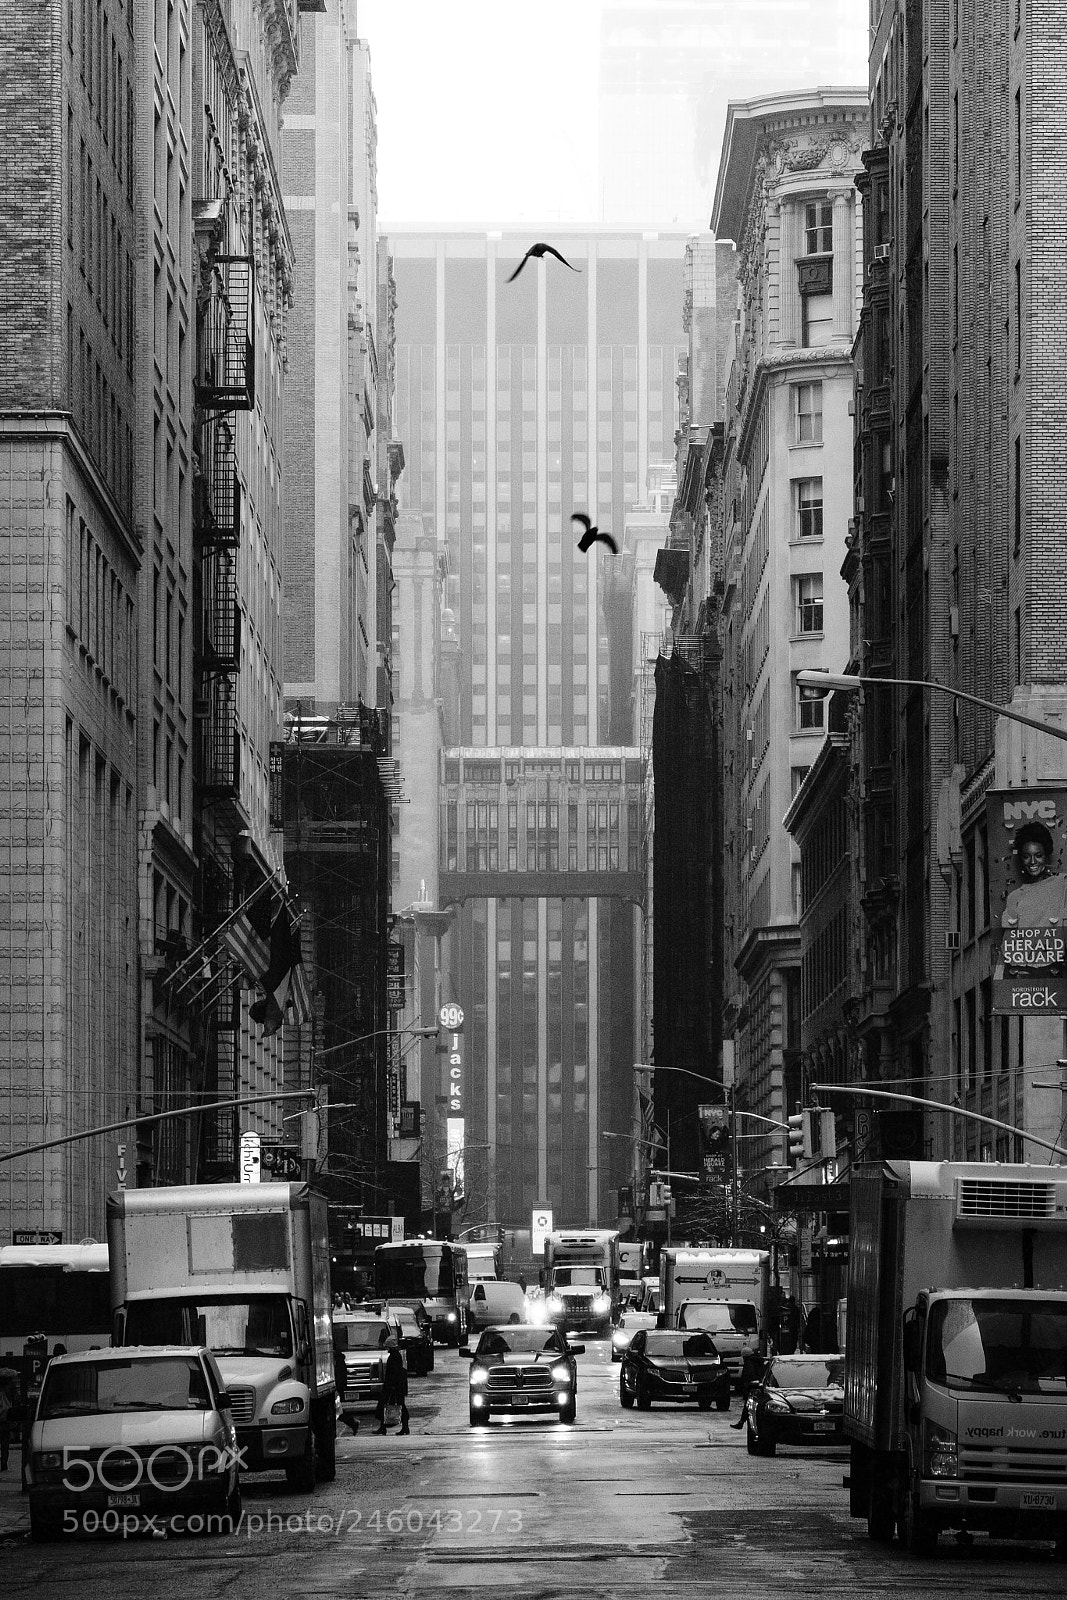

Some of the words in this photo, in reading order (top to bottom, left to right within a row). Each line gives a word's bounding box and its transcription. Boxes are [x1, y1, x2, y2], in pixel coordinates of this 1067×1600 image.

[1003, 800, 1056, 820] NYC
[1010, 929, 1040, 938] SHOP
[1044, 928, 1057, 937] AT
[1004, 939, 1064, 952] HERALD
[1003, 950, 1065, 963] SQUARE
[1012, 987, 1057, 1007] rack
[440, 1007, 464, 1026] 99¢
[449, 1033, 462, 1111] jacks
[704, 1109, 723, 1118] NYC
[705, 1174, 723, 1183] rack
[19, 1235, 34, 1243] ONE
[32, 1360, 41, 1373] P
